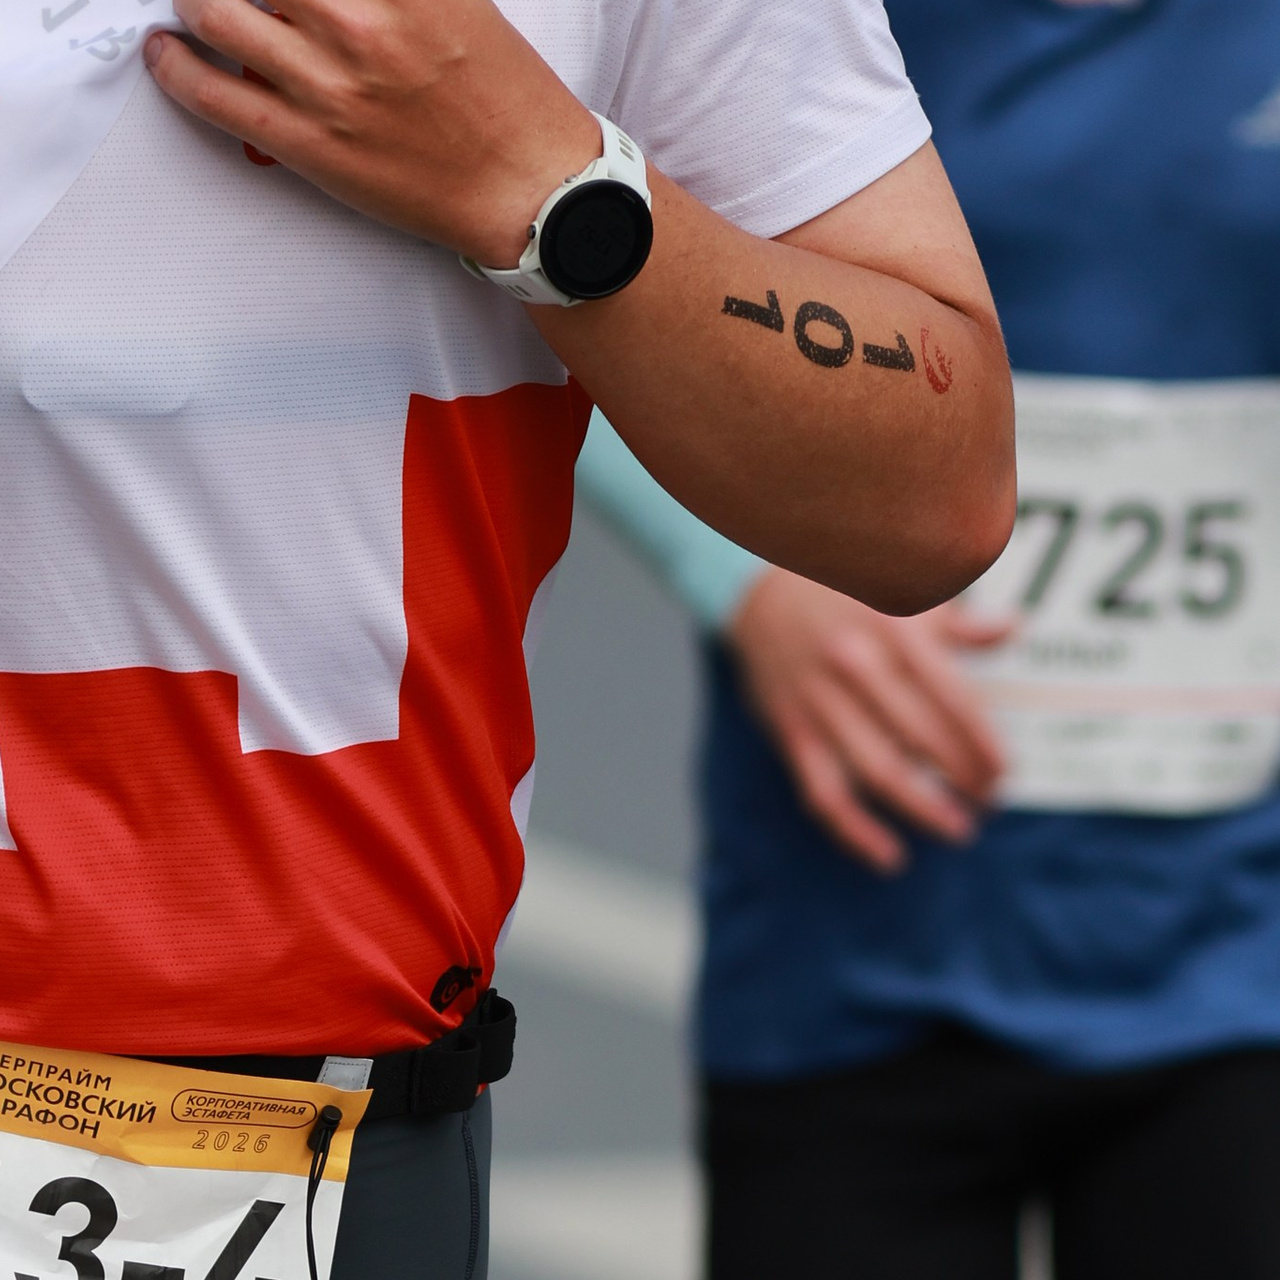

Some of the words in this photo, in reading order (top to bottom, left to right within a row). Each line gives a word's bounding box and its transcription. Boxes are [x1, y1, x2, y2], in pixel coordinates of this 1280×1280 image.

[721, 289, 916, 373] 101
[182, 1106, 252, 1120] ЭСТАФЕТА
[186, 1094, 307, 1116] КОРПОРАТИВНАЯ
[192, 1129, 271, 1154] 2026
